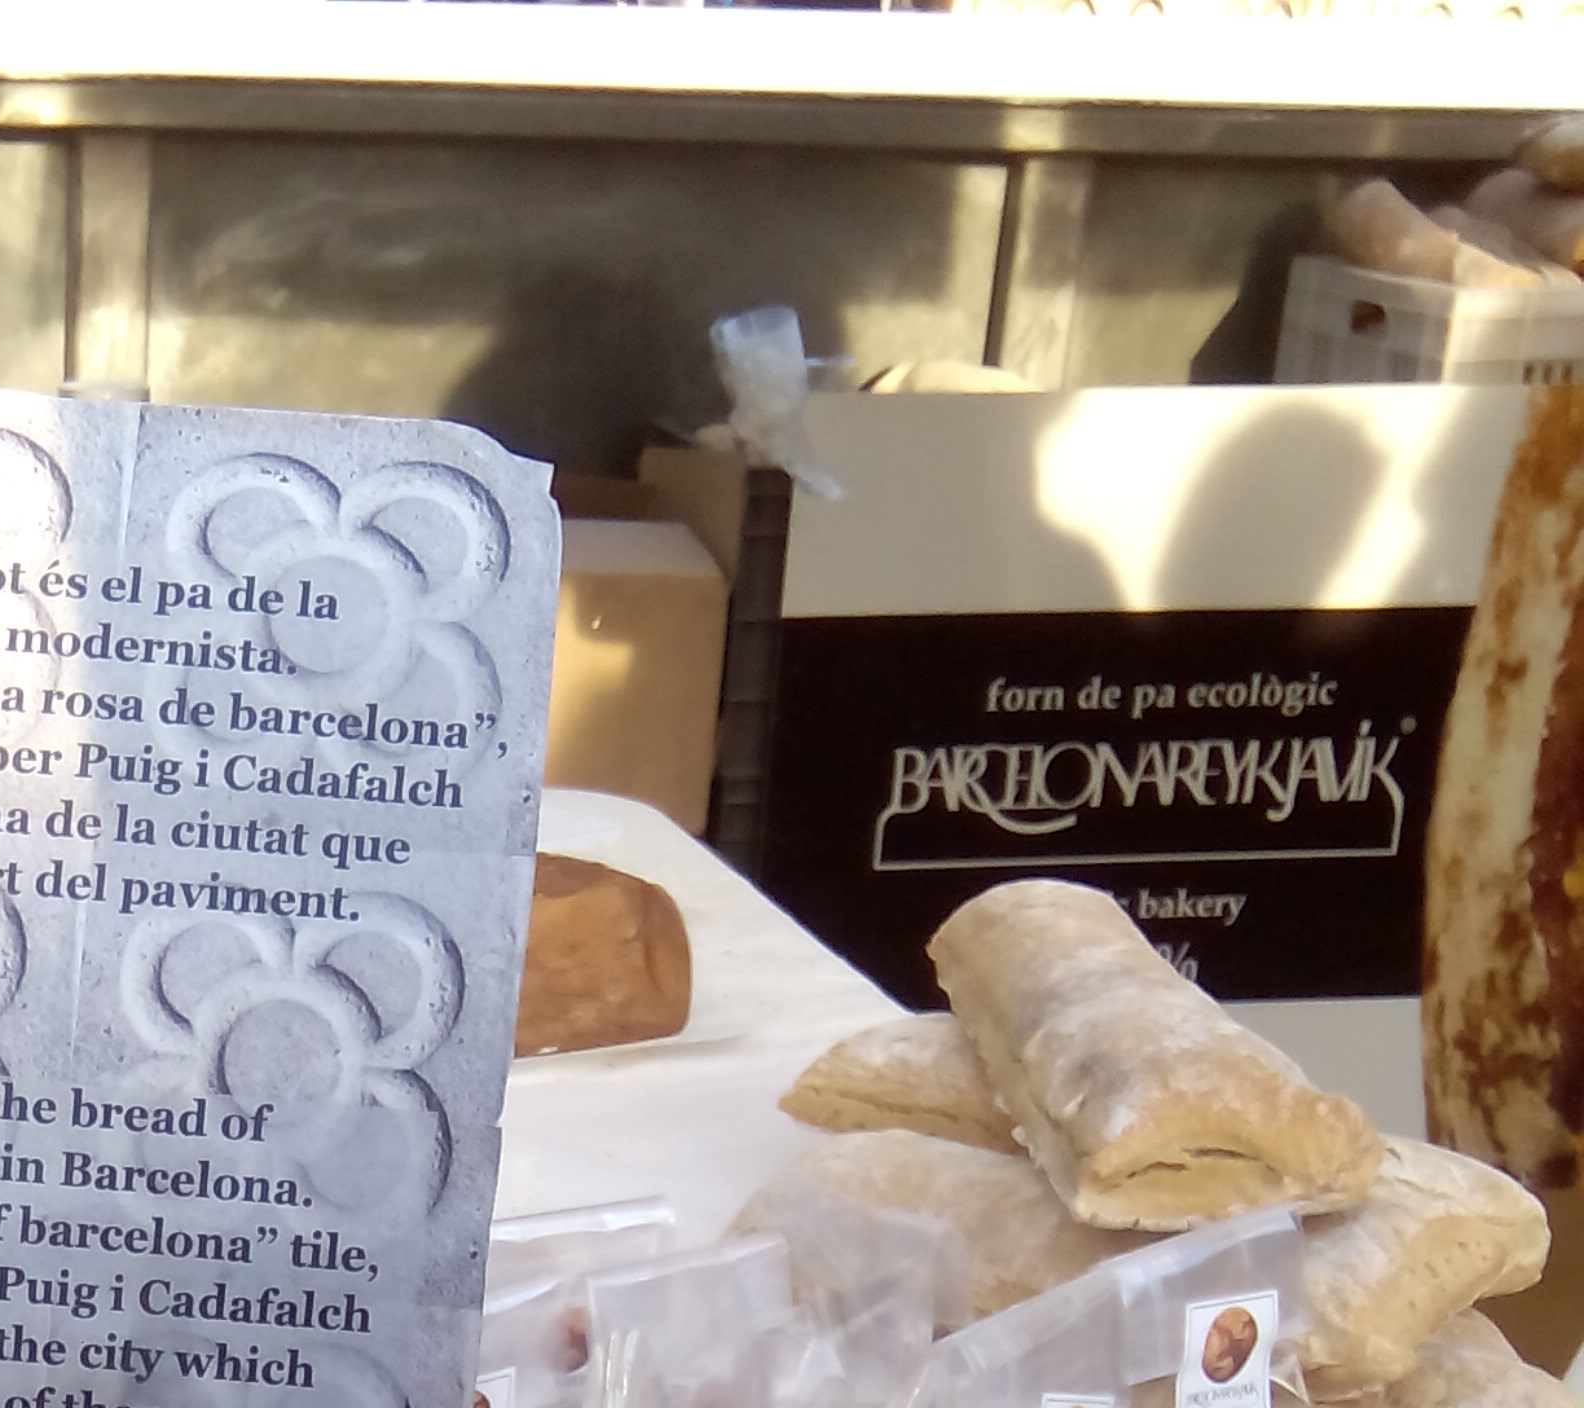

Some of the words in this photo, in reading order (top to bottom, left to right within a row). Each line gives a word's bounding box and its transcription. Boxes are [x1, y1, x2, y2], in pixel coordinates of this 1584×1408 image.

[39, 561, 89, 599] és
[101, 567, 143, 605] el
[156, 579, 214, 616] pa
[228, 574, 286, 615] de
[295, 579, 339, 621] la
[6, 624, 298, 675] modernista.
[41, 689, 146, 723] rosa
[159, 688, 216, 728] de
[986, 678, 1065, 714] forn
[1078, 676, 1123, 708] de
[1133, 686, 1176, 719] pa
[1187, 671, 1338, 716] ecològic
[75, 744, 182, 796] Puig
[194, 753, 211, 788] i
[223, 754, 463, 809] Cadafalch
[45, 801, 102, 840] de
[114, 805, 156, 846] la
[171, 813, 309, 857] ciutat
[321, 831, 411, 870] que
[36, 862, 107, 903] del
[120, 880, 361, 922] paviment.
[1139, 887, 1248, 926] bakery
[71, 1087, 207, 1137] bread
[220, 1103, 274, 1142] of
[0, 1145, 44, 1185] in
[60, 1150, 315, 1208] Barcelona.
[289, 1233, 379, 1281] tile,
[109, 1278, 124, 1311] i
[139, 1279, 372, 1333] Cadafalch
[80, 1338, 164, 1382] city
[174, 1347, 315, 1387] which
